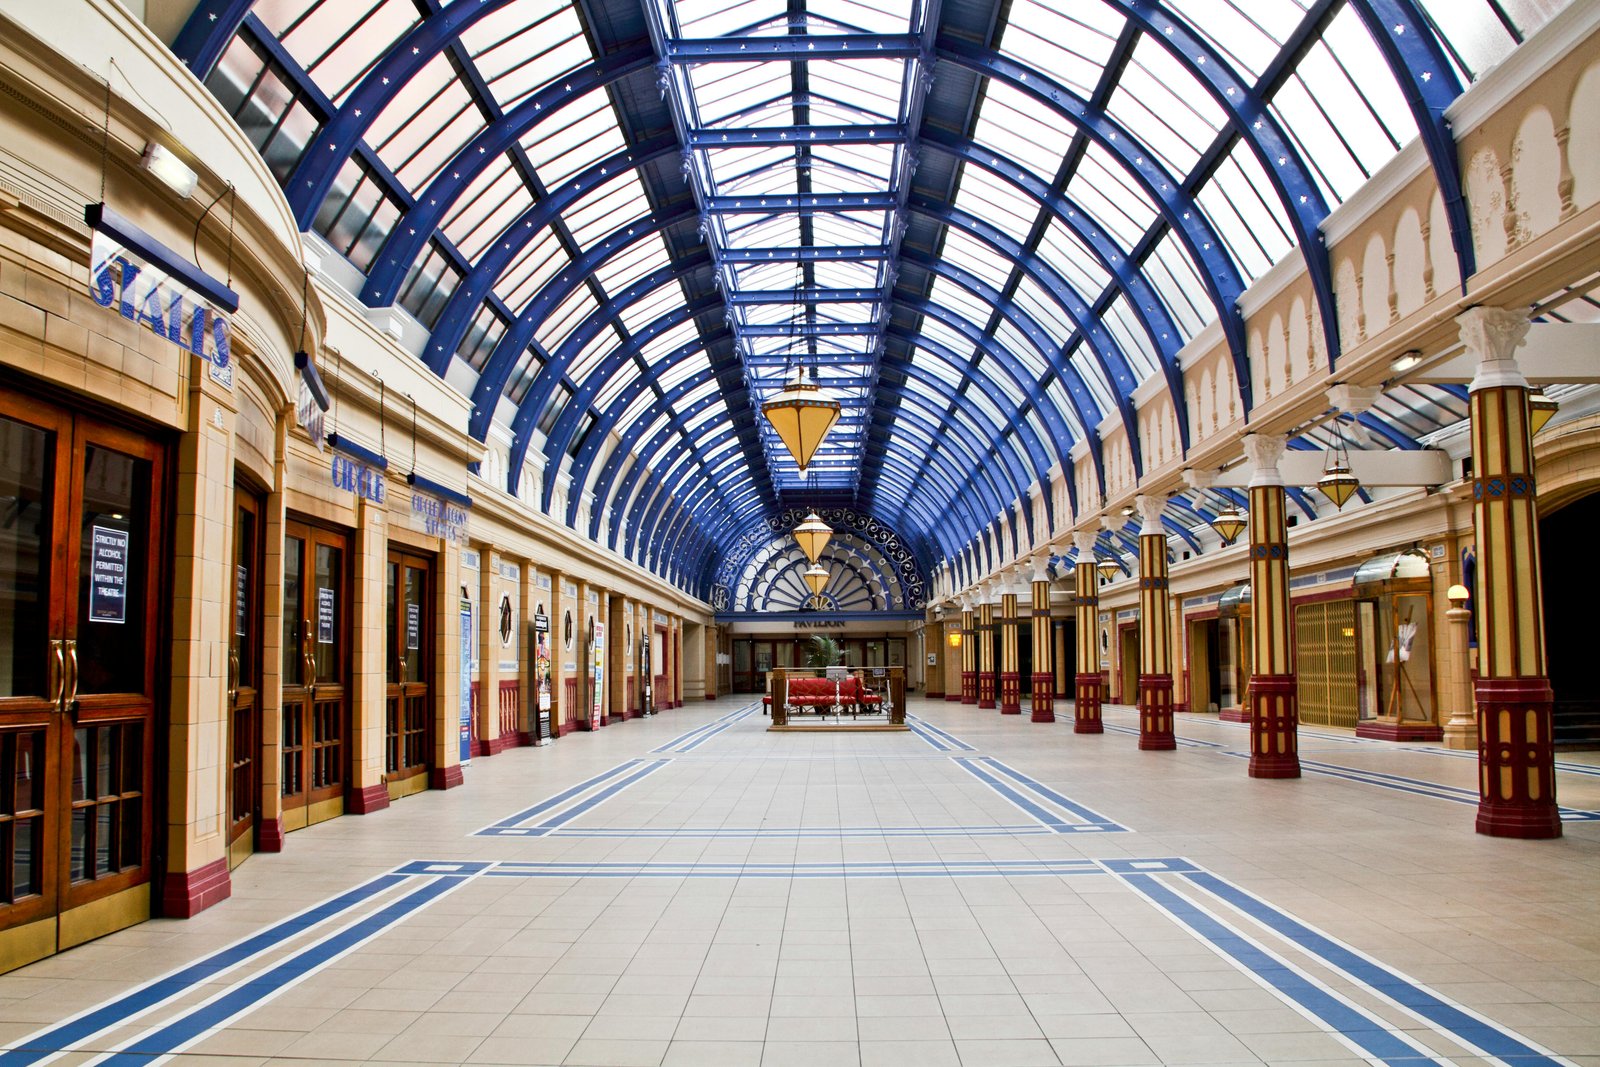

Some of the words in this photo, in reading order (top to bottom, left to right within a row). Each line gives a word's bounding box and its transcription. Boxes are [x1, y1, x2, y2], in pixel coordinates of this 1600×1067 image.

[89, 245, 231, 368] STALLS
[331, 455, 385, 504] CIRCLE
[96, 535, 116, 546] STRICTLY
[117, 539, 125, 547] NO
[99, 549, 121, 559] ALCOHOL
[96, 561, 123, 572] PERMITTED
[95, 574, 113, 583] WITHIN
[114, 576, 123, 584] THE
[98, 587, 119, 597] THEATRE
